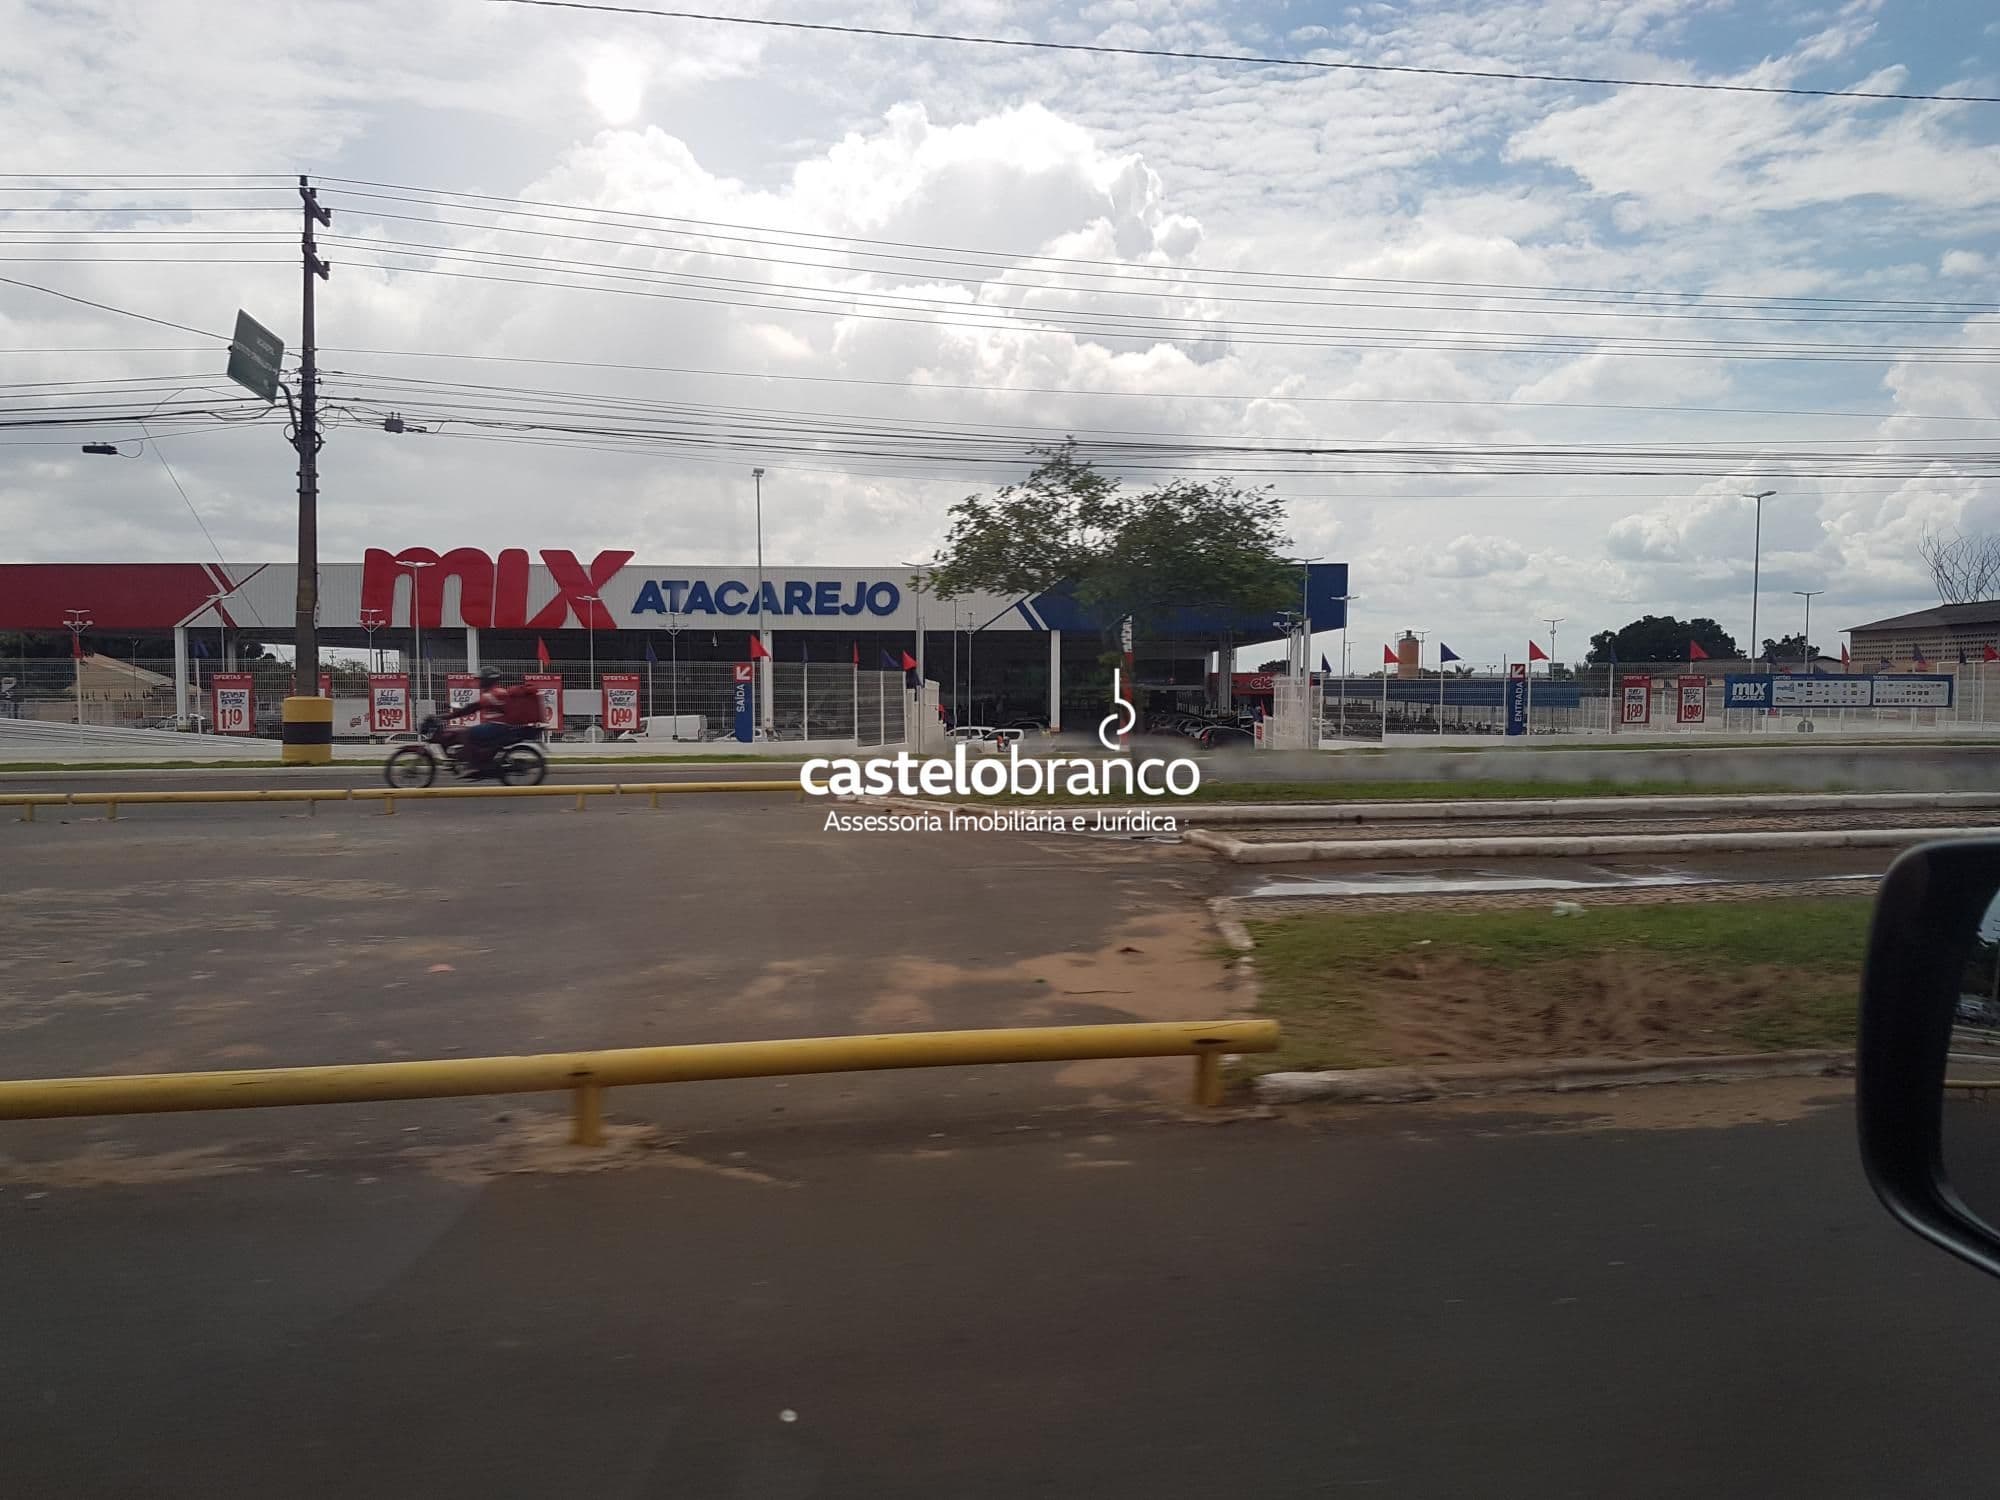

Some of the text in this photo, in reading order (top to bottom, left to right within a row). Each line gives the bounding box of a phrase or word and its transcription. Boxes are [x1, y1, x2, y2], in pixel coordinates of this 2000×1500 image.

[631, 580, 900, 616] ATACAREJO
[735, 683, 745, 713] SAÍDA
[1514, 681, 1524, 722] ENTRADA
